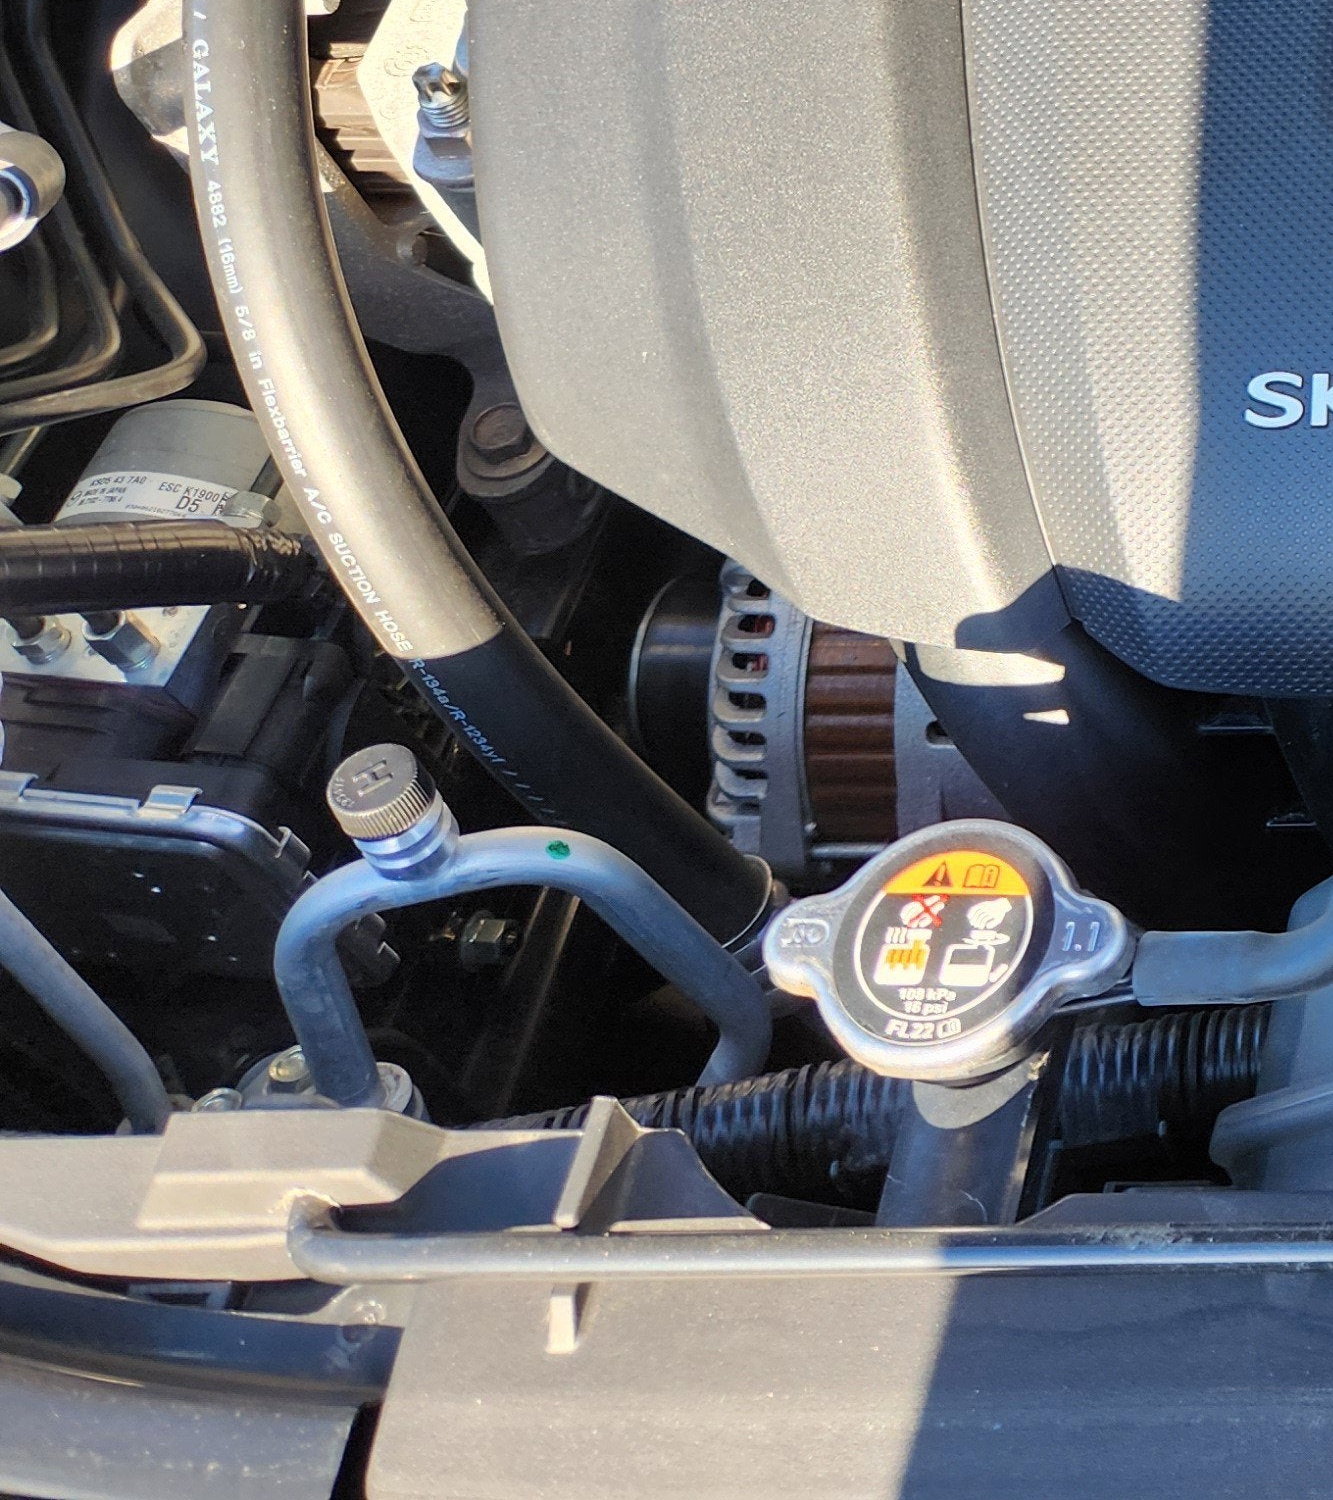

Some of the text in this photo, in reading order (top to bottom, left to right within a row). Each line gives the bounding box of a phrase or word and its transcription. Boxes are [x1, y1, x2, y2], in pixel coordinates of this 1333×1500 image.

[191, 38, 506, 764] GALAXY 4882 (16mm) 5/8 in Flexbarrier A/C SUCTION HOSE R-134a/R-1234yf
[158, 481, 182, 493] ESC
[175, 495, 203, 513] D5
[352, 758, 395, 797] H
[1062, 921, 1101, 952] 1.1
[926, 986, 957, 1002] kPa
[921, 1000, 949, 1016] psi
[884, 1018, 936, 1040] FL22
